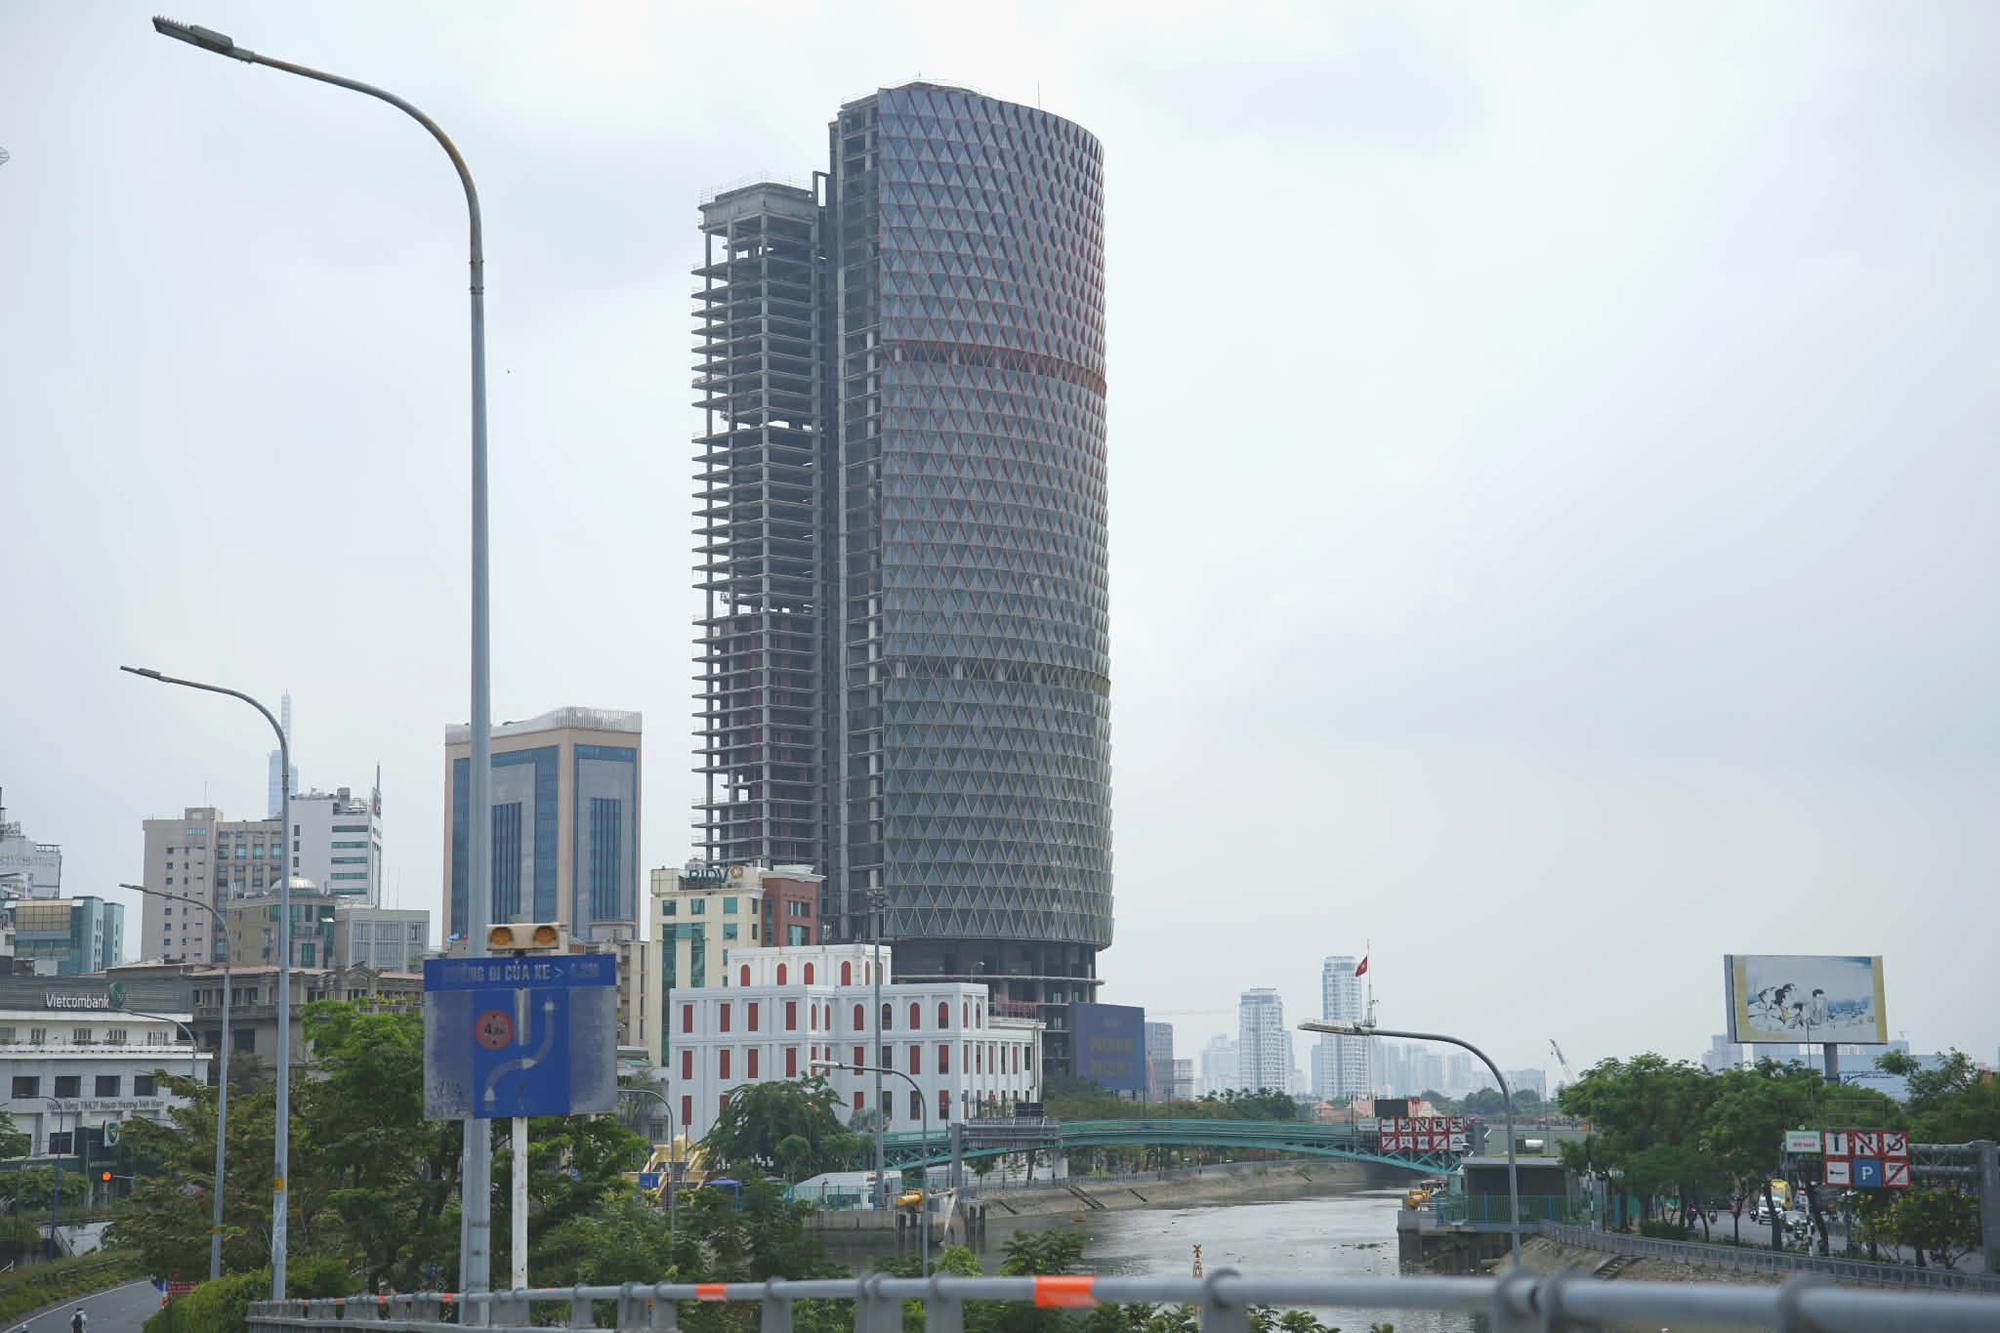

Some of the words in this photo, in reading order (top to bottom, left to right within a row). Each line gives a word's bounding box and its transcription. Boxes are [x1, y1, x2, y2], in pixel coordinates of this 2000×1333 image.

[534, 964, 550, 980] XE
[46, 991, 110, 1009] Vietcombank
[1862, 1166, 1874, 1181] P
